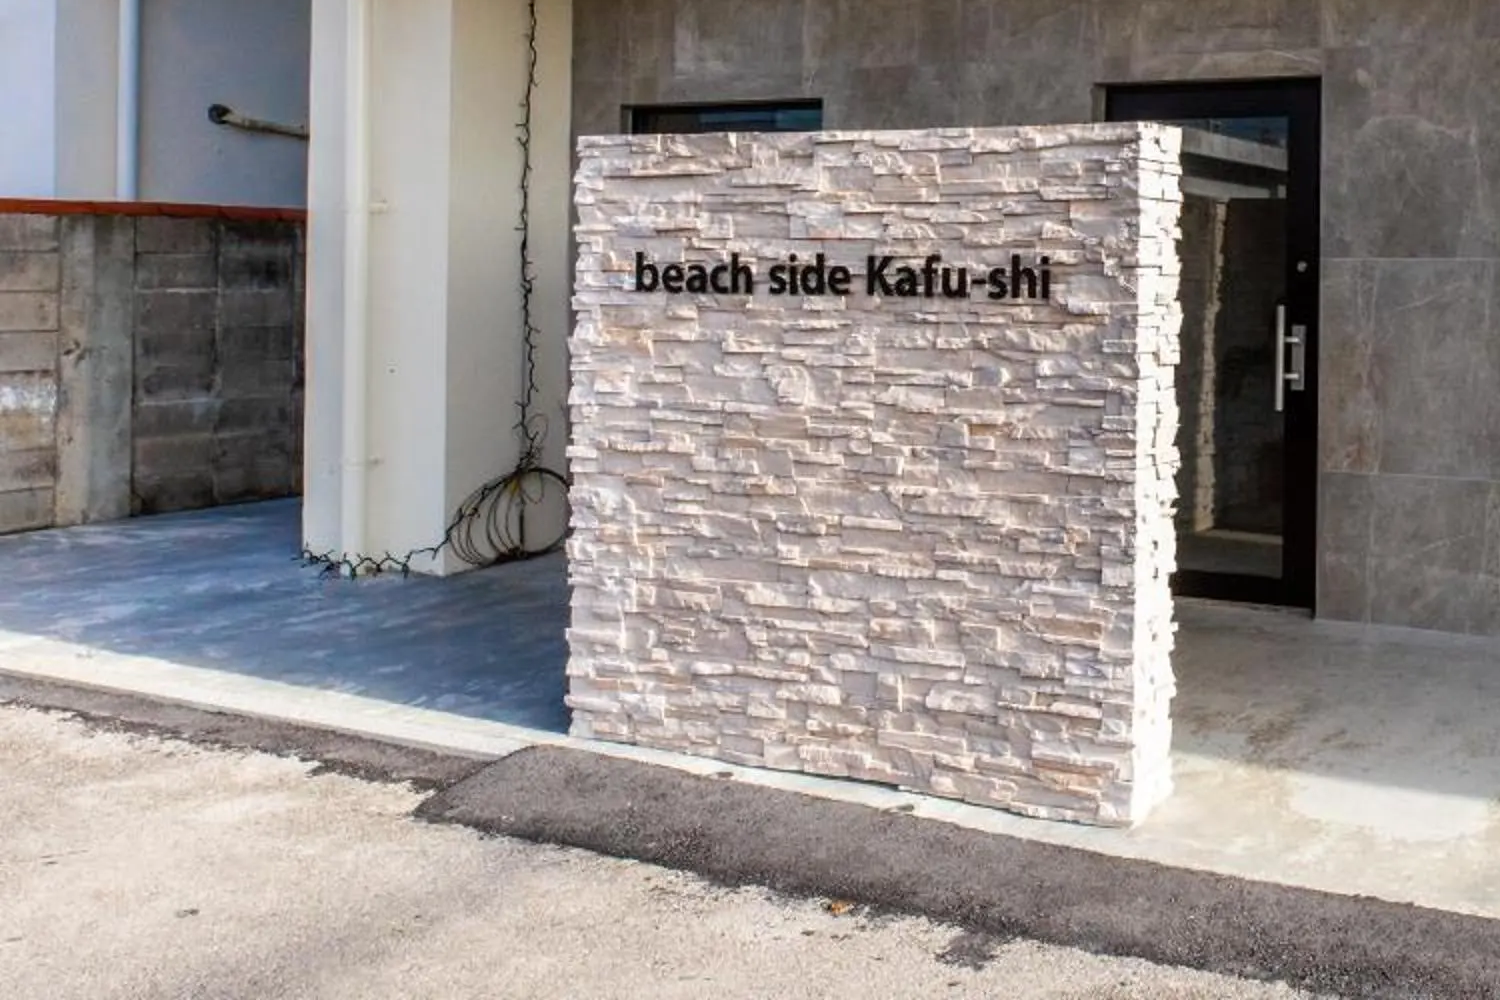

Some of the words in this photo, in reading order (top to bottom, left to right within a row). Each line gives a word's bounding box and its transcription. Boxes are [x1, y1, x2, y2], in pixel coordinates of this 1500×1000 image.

[634, 251, 754, 294] beach
[768, 253, 852, 296] side
[866, 253, 1052, 299] Kafu-shi
